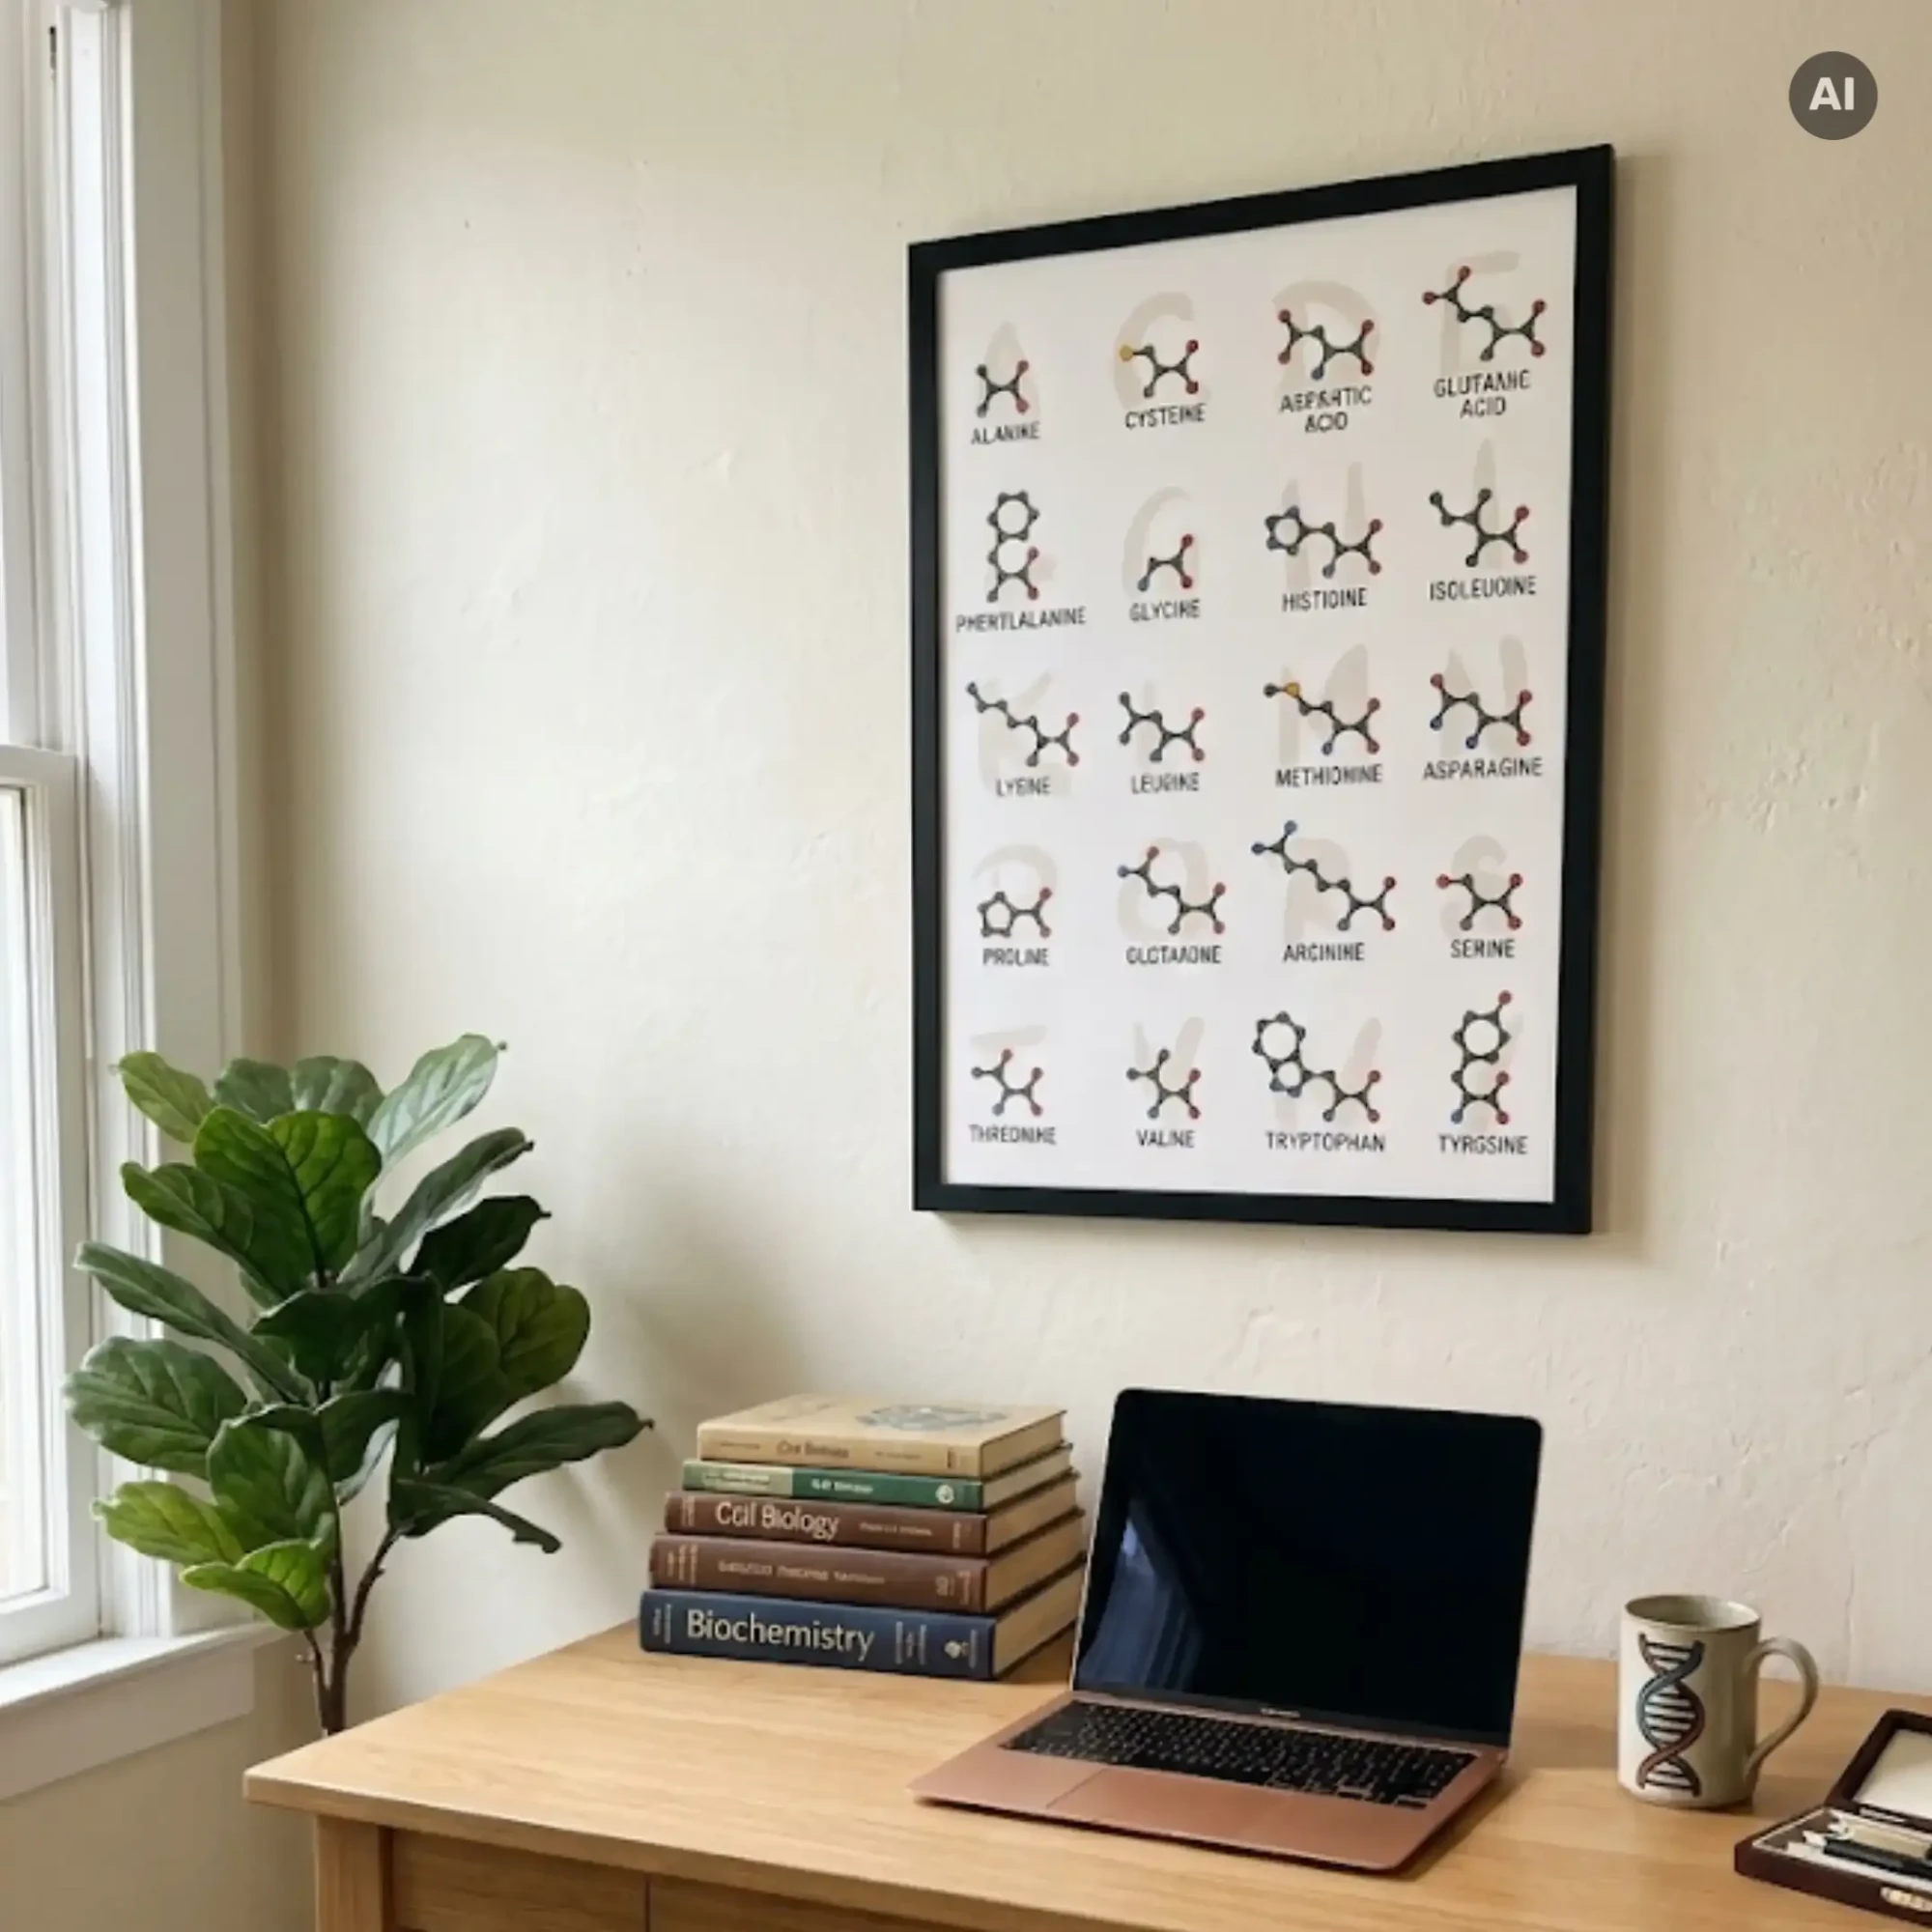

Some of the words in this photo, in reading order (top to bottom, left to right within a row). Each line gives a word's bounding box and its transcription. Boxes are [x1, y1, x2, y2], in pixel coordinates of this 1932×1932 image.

[1422, 756, 1543, 781] ASPARAGINE
[1265, 1131, 1385, 1153] TRYPTOPHAN
[686, 1607, 875, 1662] Biochemistry
